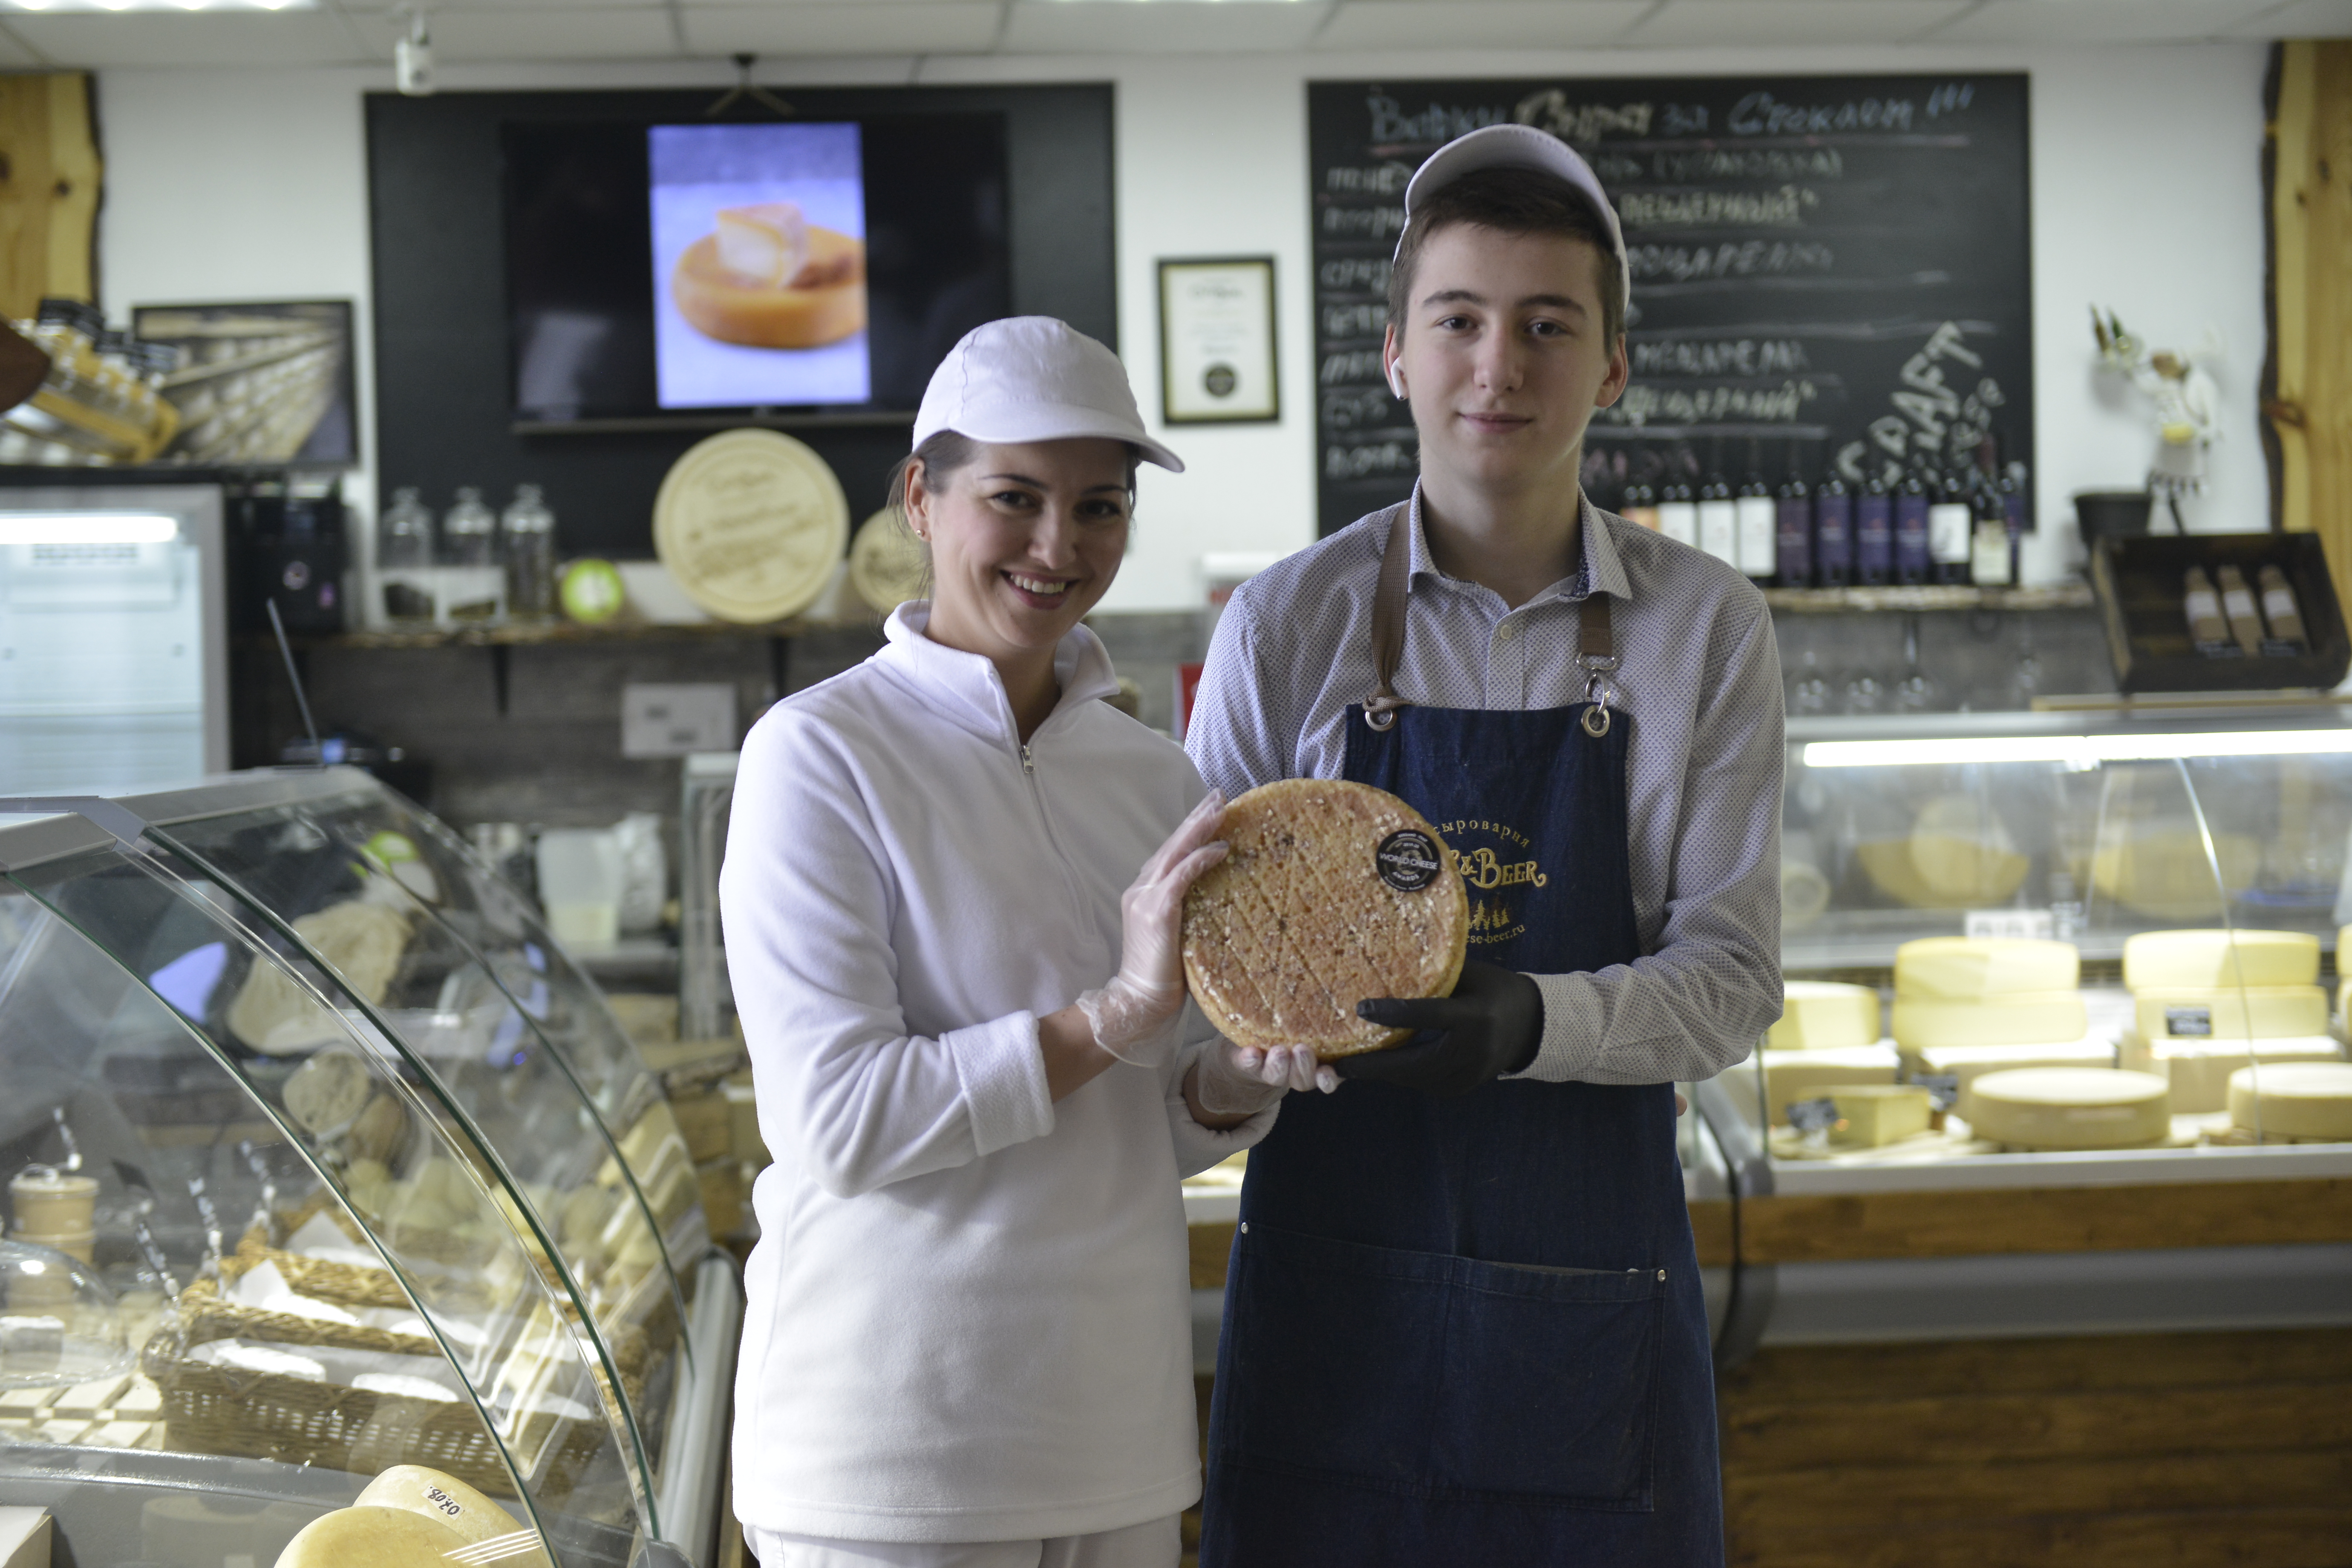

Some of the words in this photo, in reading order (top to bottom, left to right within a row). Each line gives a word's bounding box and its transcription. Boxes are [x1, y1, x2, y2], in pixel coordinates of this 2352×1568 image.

[1433, 820, 1529, 848] сыроварня
[1379, 852, 1409, 864] WORLD
[1410, 858, 1438, 870] CHEESE
[1460, 855, 1478, 875] &
[1392, 871, 1420, 882] AWARDS
